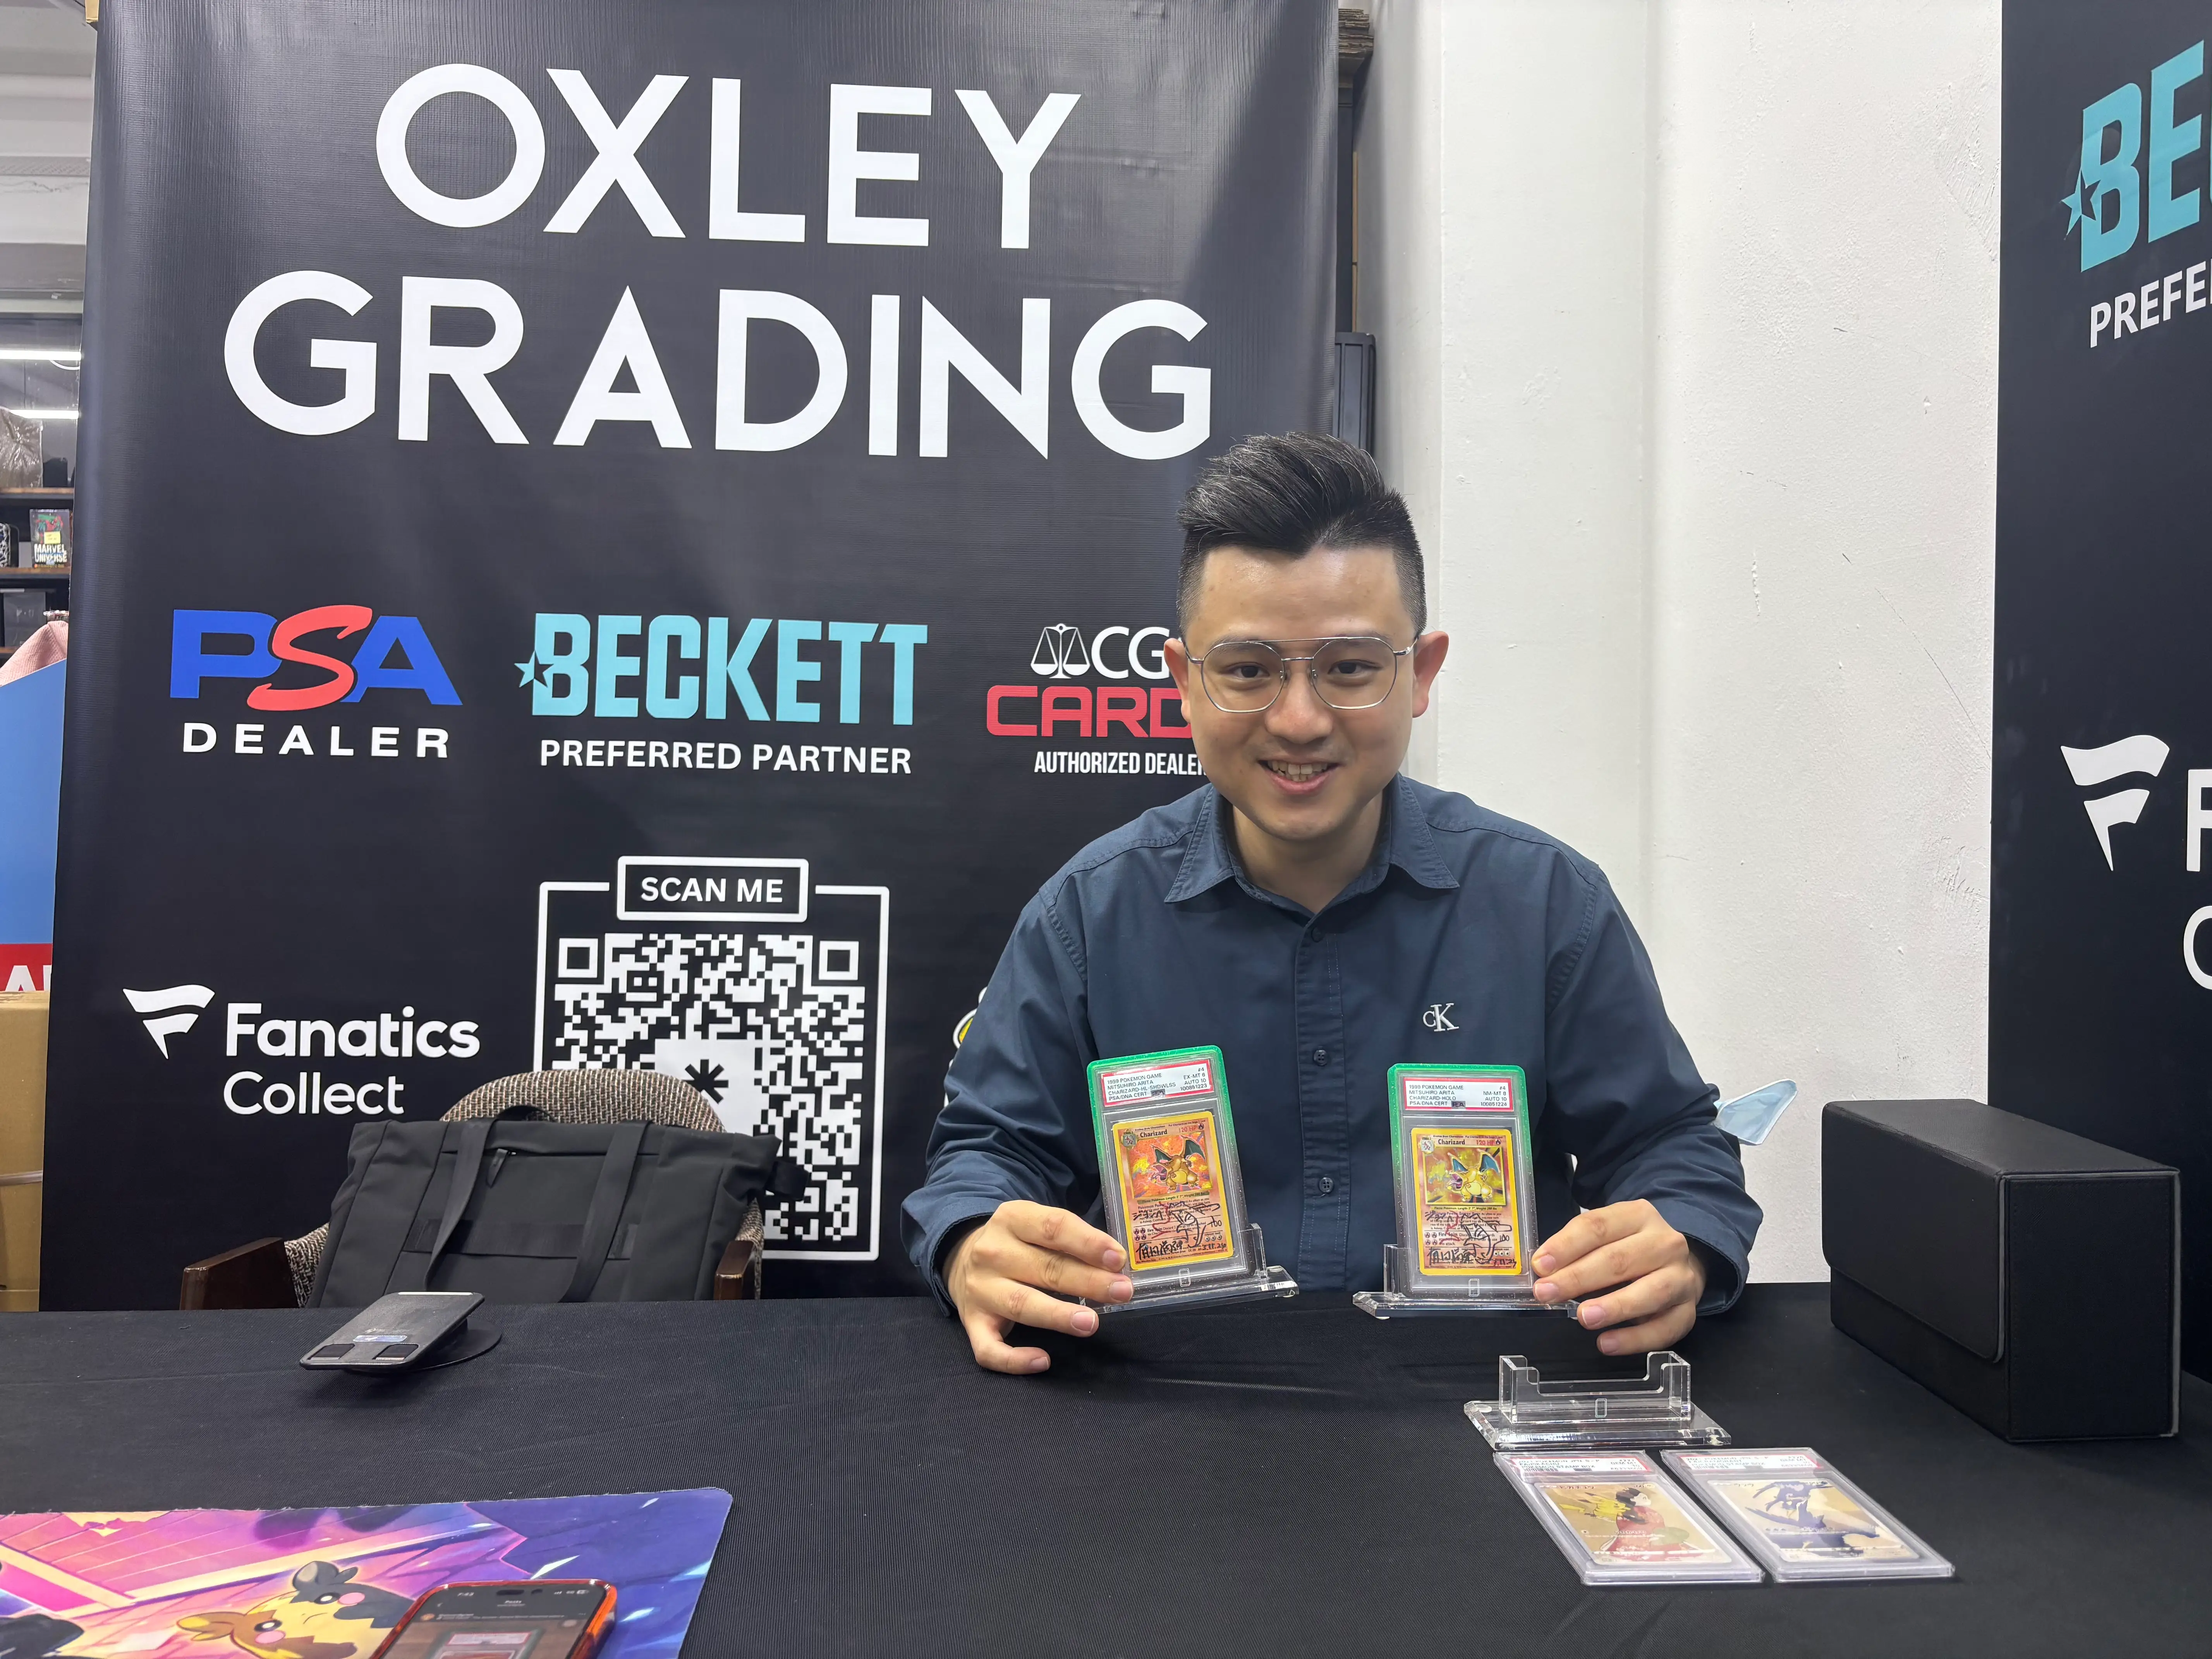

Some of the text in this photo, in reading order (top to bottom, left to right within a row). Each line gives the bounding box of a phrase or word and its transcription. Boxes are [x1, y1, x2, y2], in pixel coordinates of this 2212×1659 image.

[376, 63, 1082, 249] OXLEY
[2059, 40, 2212, 272] BE
[2090, 259, 2212, 348] PREFE
[224, 271, 1211, 460] GRADING
[34, 543, 65, 553] MARVEL
[170, 606, 462, 711] PSA
[517, 613, 927, 725] BECKETT
[1091, 626, 1181, 679] CG
[987, 685, 1192, 738] CARD
[184, 723, 448, 758] DEALER
[541, 740, 910, 774] PREFERRED PARTNER
[1034, 751, 1140, 774] AUTHORIZED
[641, 877, 783, 903] SCAN ME
[227, 1003, 479, 1057] Fanatics
[224, 1072, 404, 1114] Collect
[1140, 1129, 1168, 1137] Charizard
